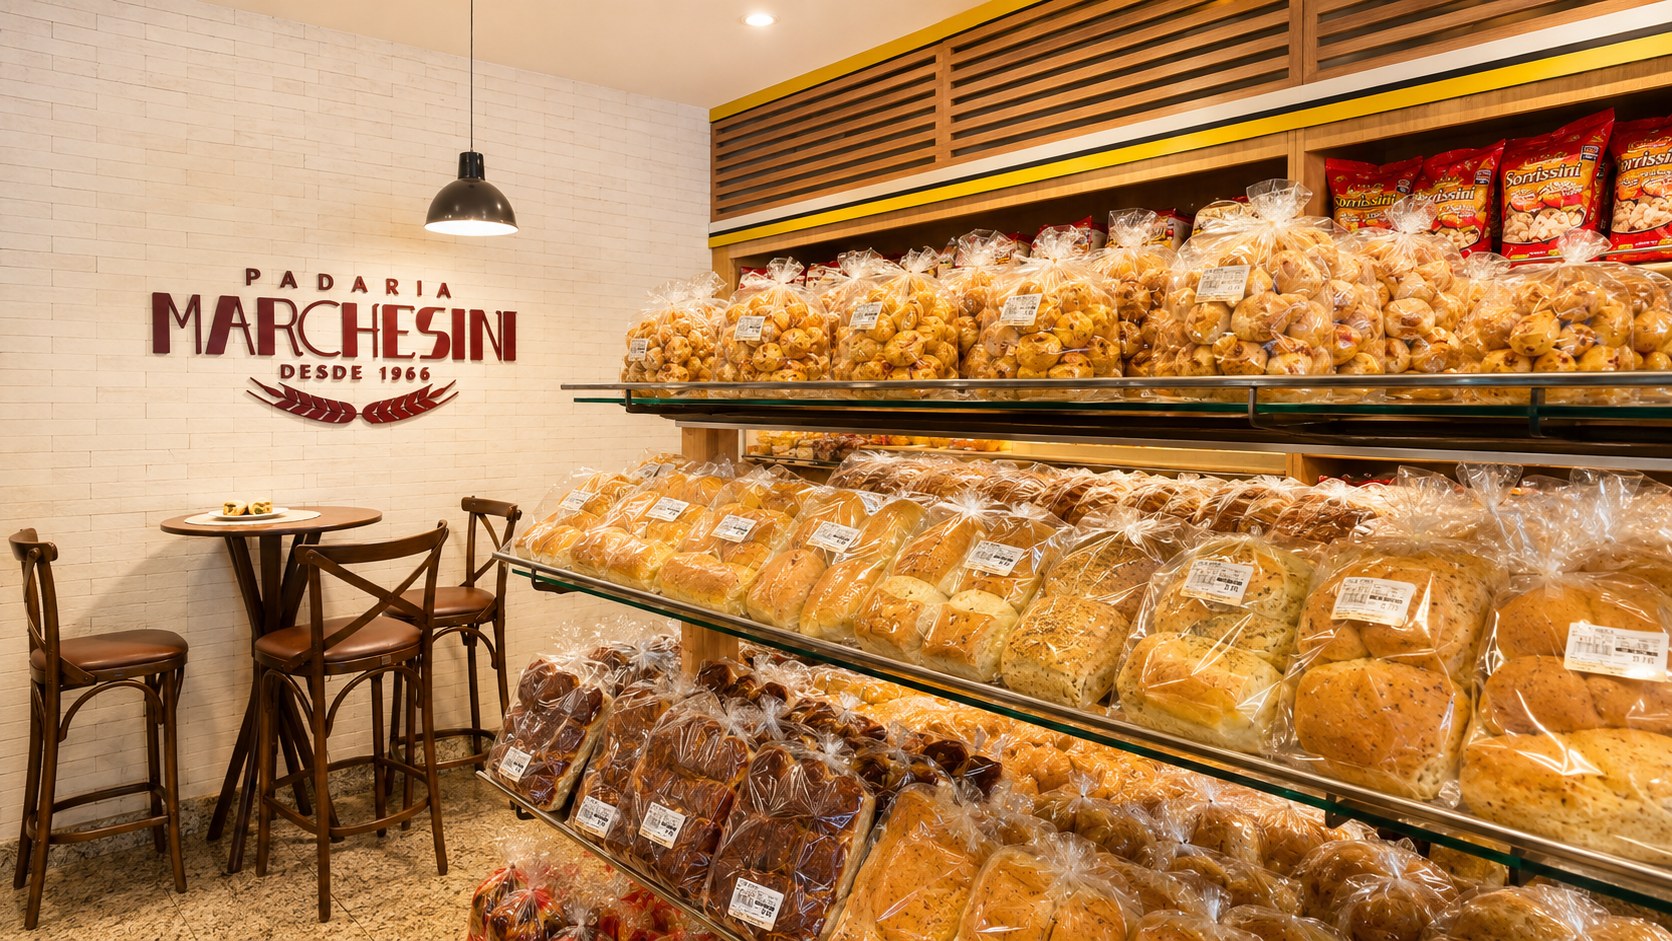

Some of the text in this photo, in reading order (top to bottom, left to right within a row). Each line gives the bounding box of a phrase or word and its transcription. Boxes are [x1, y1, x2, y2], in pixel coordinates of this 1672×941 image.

[1505, 162, 1582, 189] Sorrissini
[245, 267, 452, 299] PADARIA
[152, 291, 518, 362] MARCHESINI
[280, 364, 431, 381] DESDE 1966
